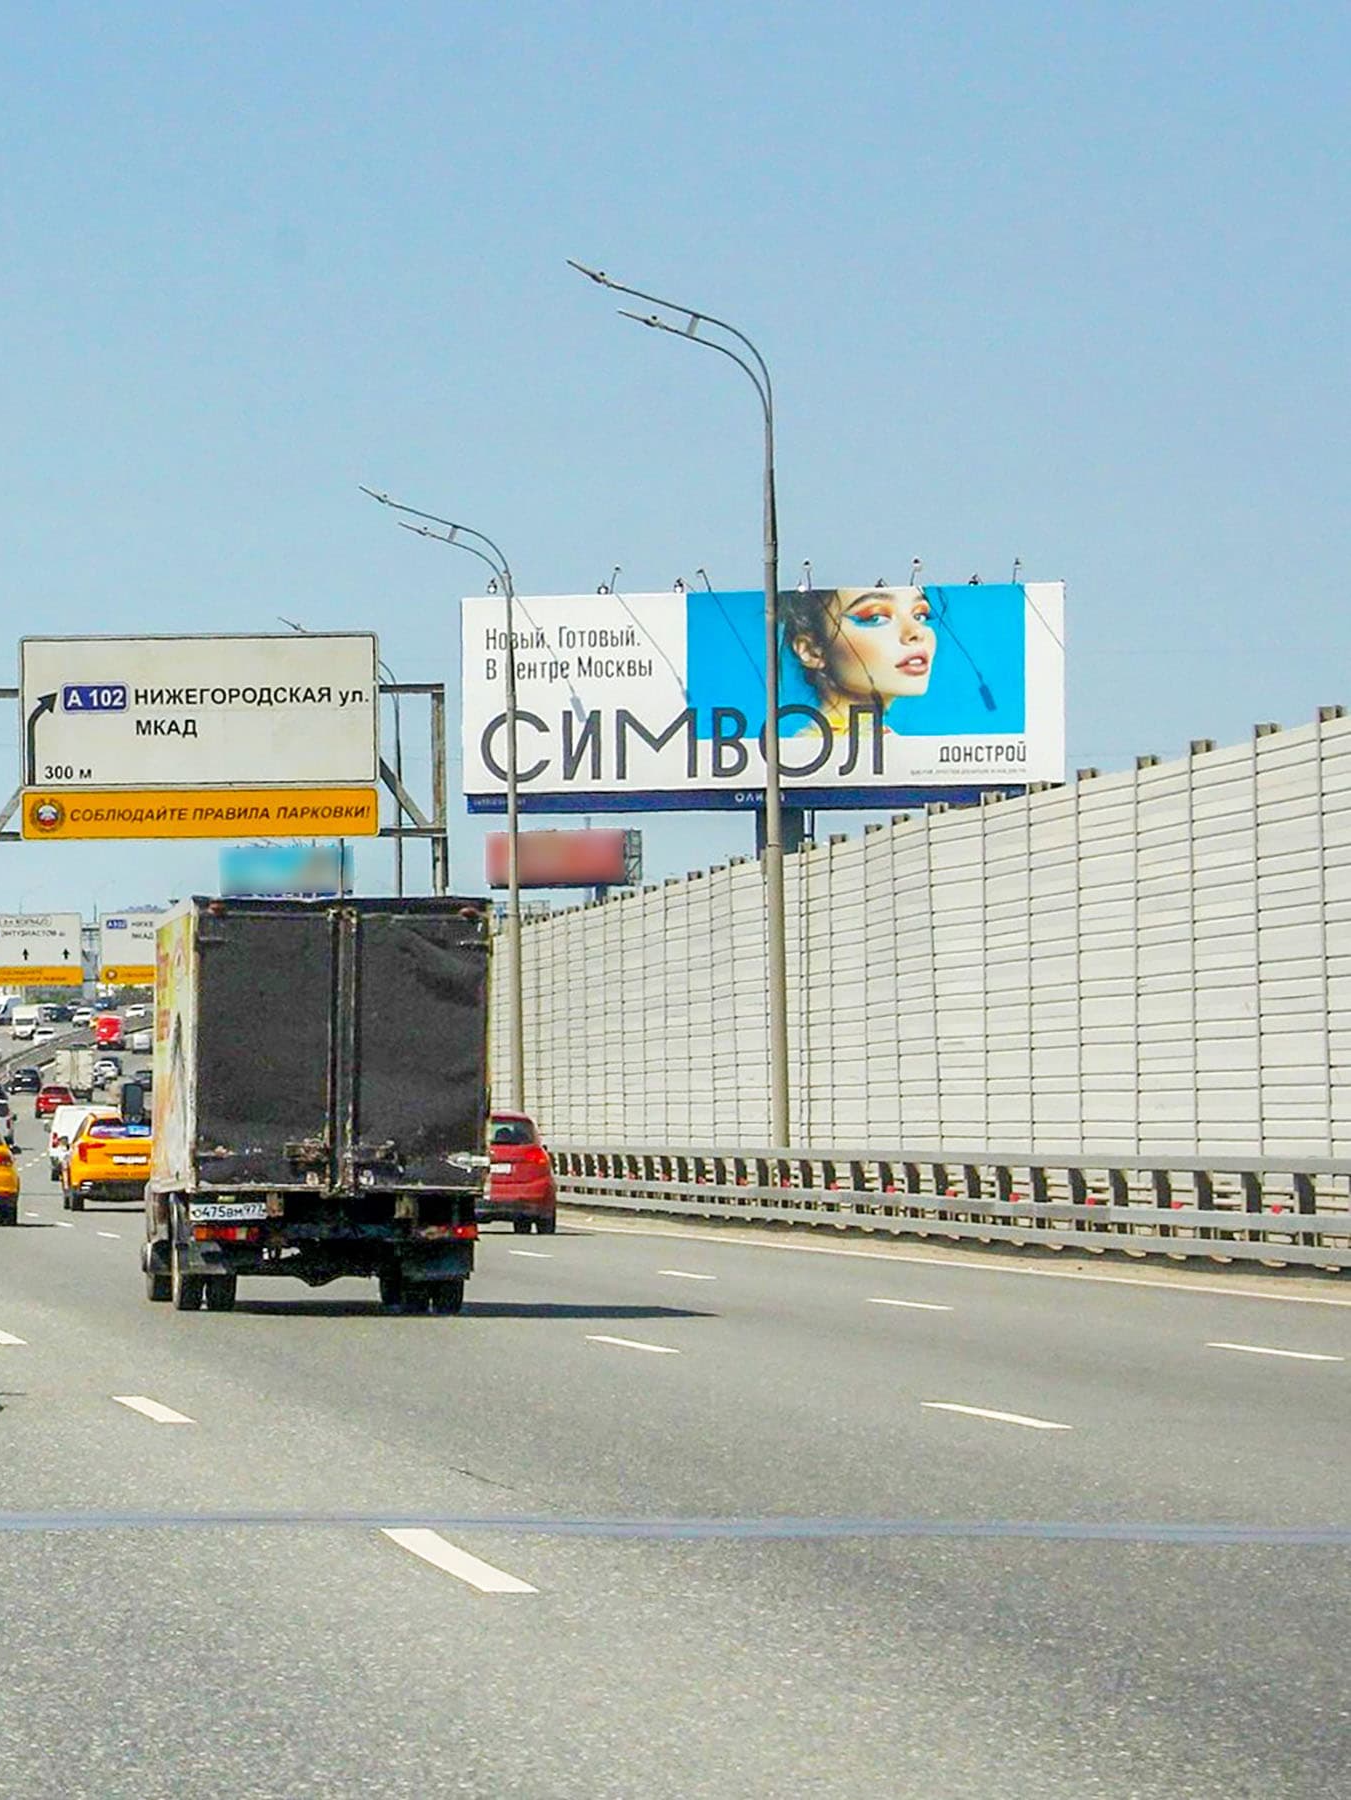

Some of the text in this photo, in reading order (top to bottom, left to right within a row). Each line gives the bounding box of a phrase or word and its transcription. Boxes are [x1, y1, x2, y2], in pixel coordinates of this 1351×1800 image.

[558, 624, 641, 649] Готовый.
[485, 656, 653, 684] В ентре Москвы
[134, 687, 370, 707] НИЖЕГОРОДСКАЯ ул.
[135, 719, 198, 738] МКАД
[480, 703, 884, 783] СИМВОЛ
[938, 741, 1027, 762] ДОНСТРОЙ
[44, 766, 92, 780] 300 м
[69, 804, 371, 822] СОБЛЮДАЙТЕ ПРАВИЛА ПАРКОВКИ!
